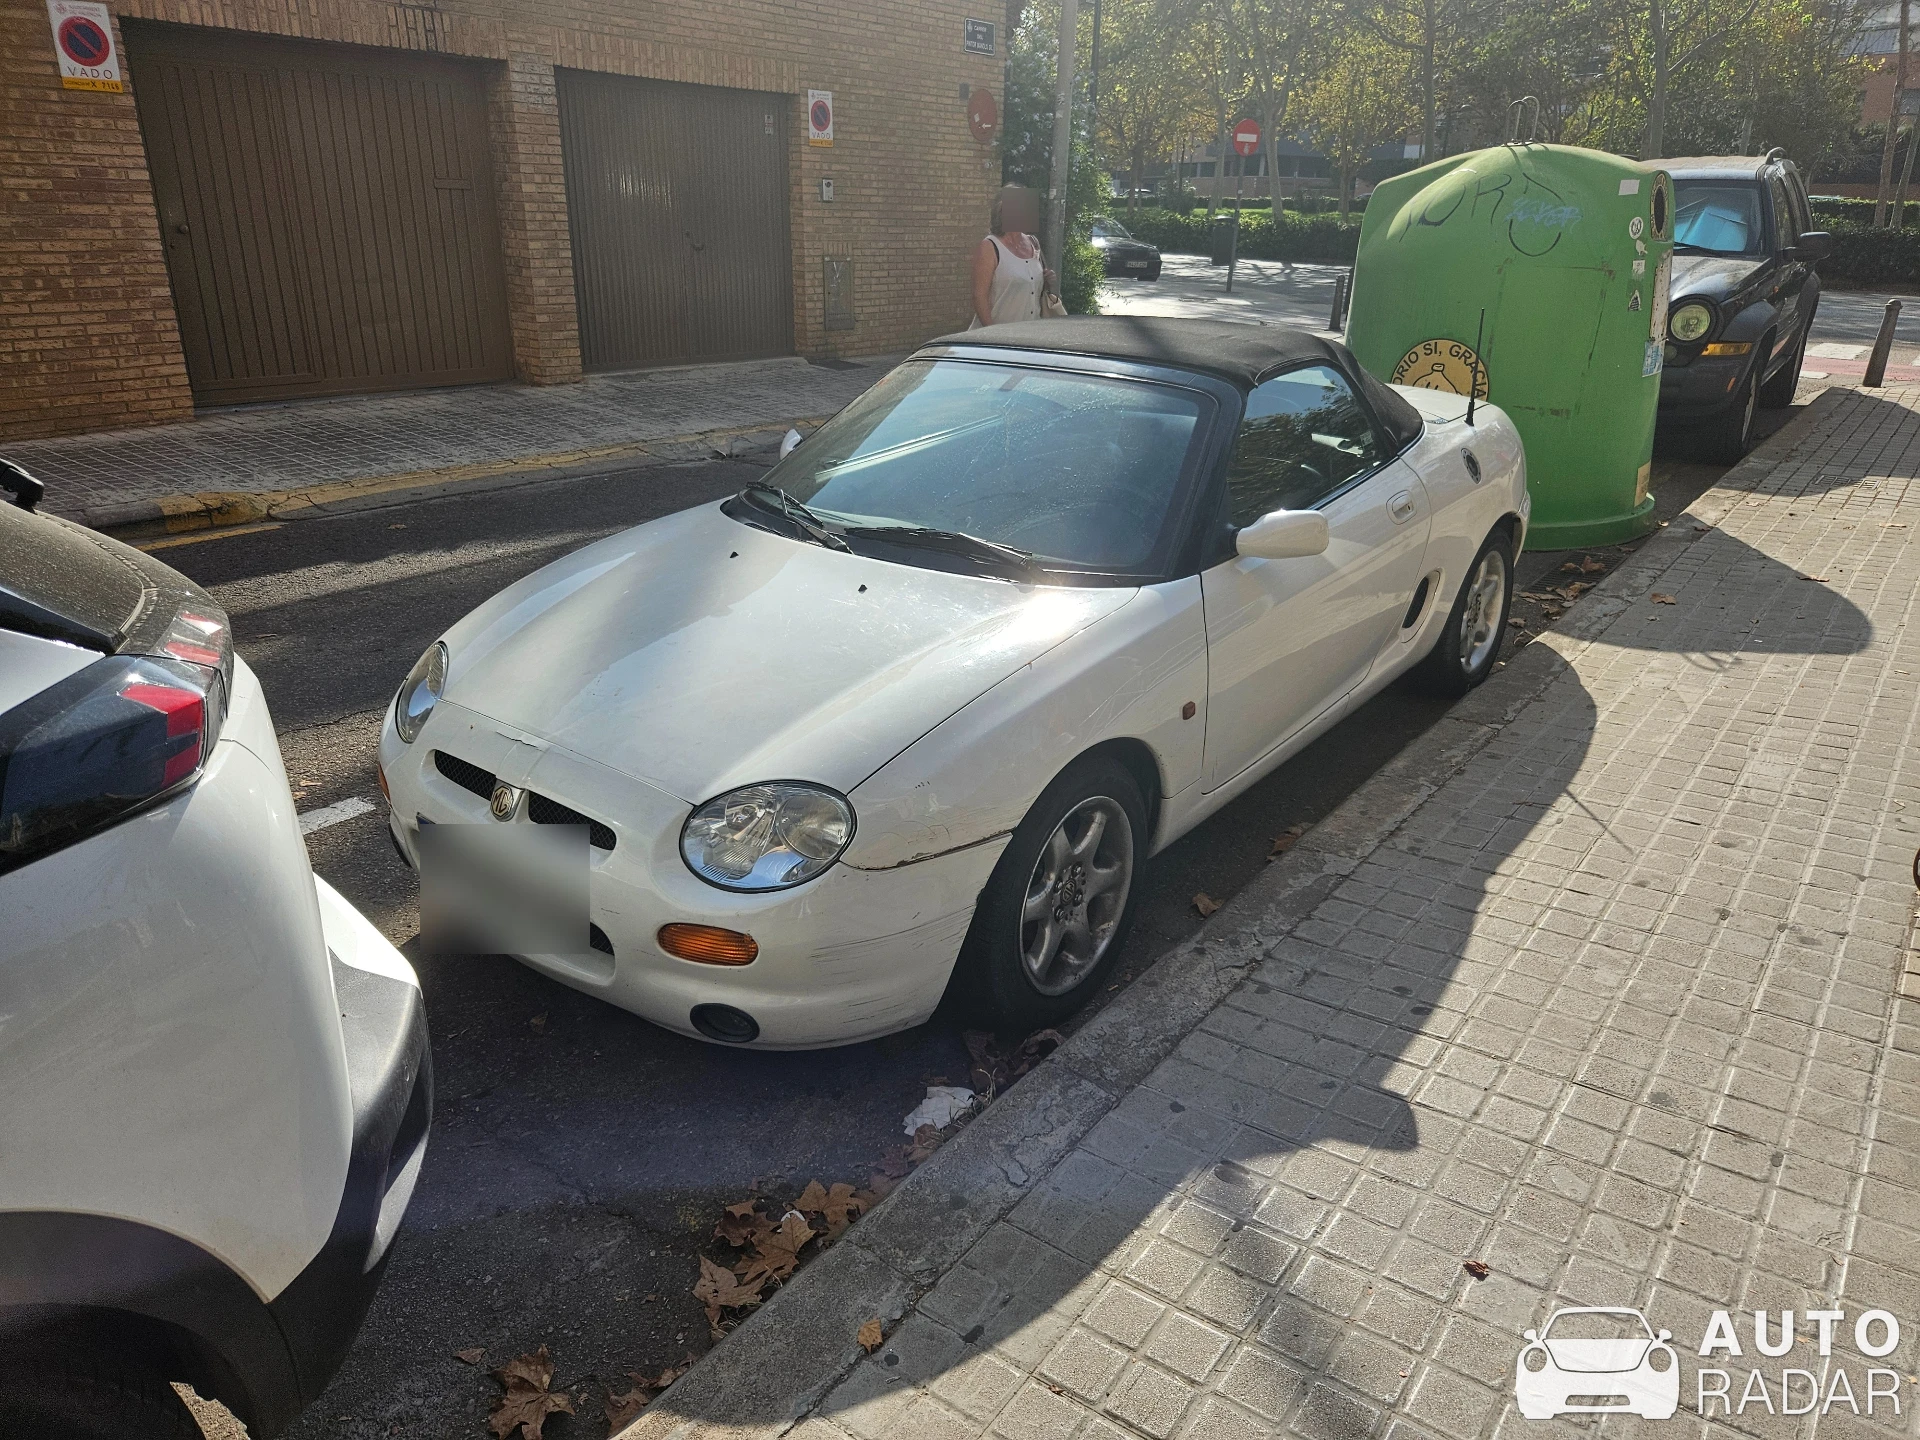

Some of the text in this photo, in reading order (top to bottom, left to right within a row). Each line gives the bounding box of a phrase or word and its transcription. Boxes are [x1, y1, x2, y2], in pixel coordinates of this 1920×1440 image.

[67, 66, 113, 79] VADO
[811, 132, 831, 140] VADO
[1392, 341, 1487, 399] DRIO SI, GRACIA
[492, 788, 510, 815] MG
